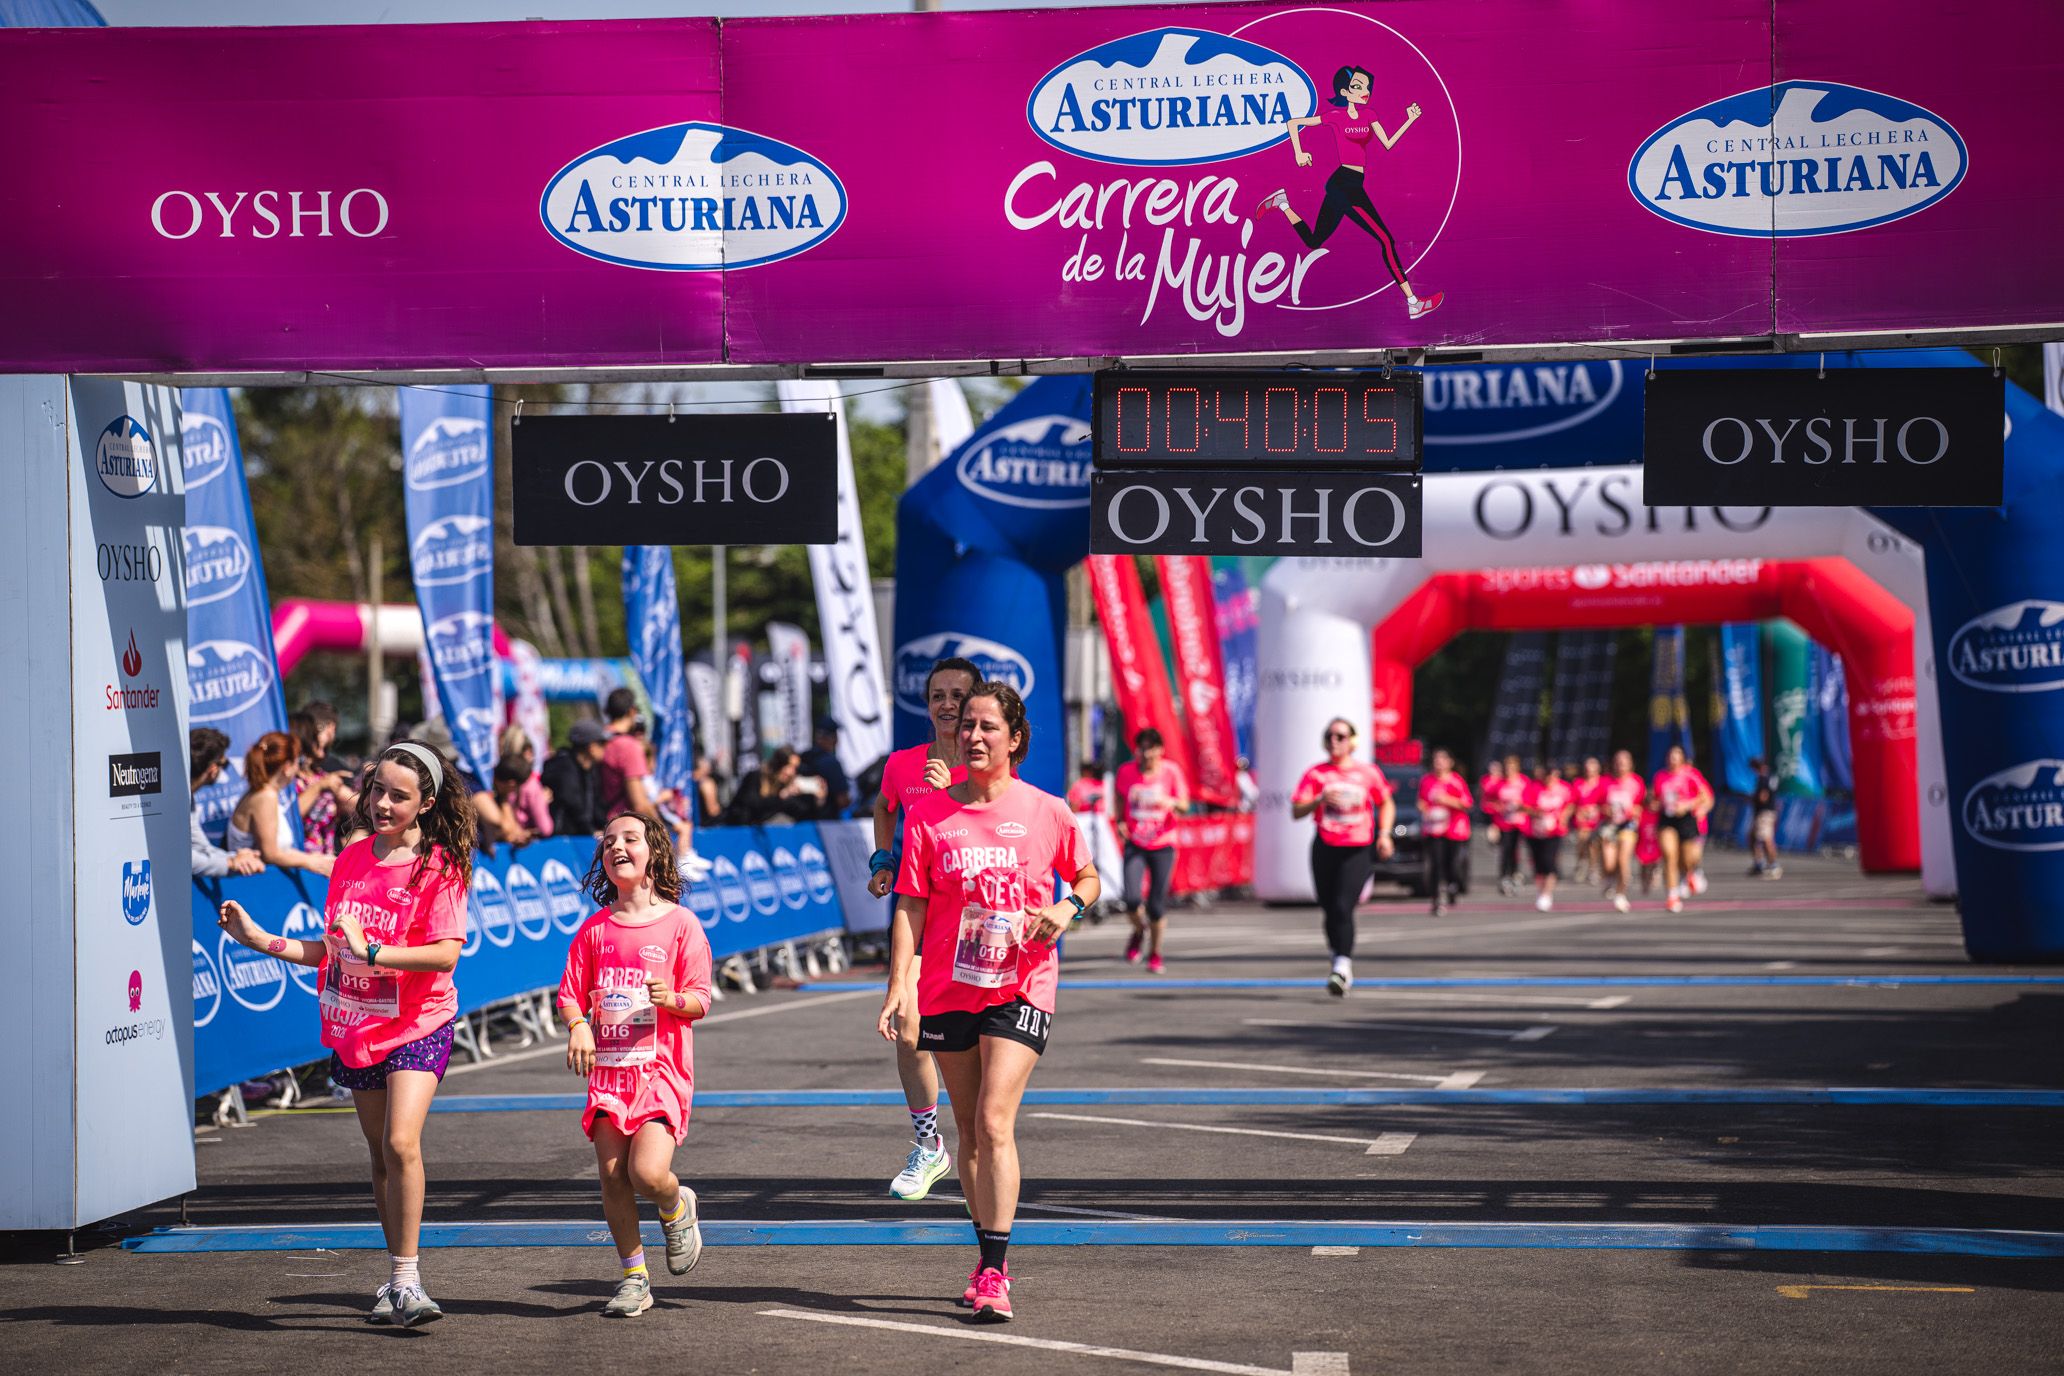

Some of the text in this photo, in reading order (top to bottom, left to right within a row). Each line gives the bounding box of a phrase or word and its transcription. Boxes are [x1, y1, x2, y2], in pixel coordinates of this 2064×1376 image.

[1093, 72, 1284, 91] CENTRAL LECHERA
[1049, 82, 1293, 133] ASTURIANA
[1345, 126, 1370, 134] OYSHO
[1706, 130, 1929, 153] CENTRAL LECHERA
[612, 172, 812, 189] CENTRAL LECHERA
[1654, 143, 1941, 201] ASTURIANA
[565, 179, 824, 233] ASTURIANA
[1003, 160, 1240, 230] Carrera
[151, 188, 389, 239] OYSHO
[1062, 217, 1330, 337] de la Mujer
[1117, 387, 1397, 452] 00:40:05
[1702, 416, 1950, 466] OYSHO
[100, 443, 154, 479] ASTURIANA
[564, 457, 789, 506] OYSHO
[1107, 484, 1406, 546] OYSHO
[97, 543, 162, 582] OYSHO
[1611, 557, 1763, 589] Santander
[106, 684, 160, 710] Santander
[112, 763, 158, 790] Neutrogena
[906, 786, 933, 794] OYSHO
[935, 828, 969, 842] OYSHO
[979, 945, 1007, 960] 016
[342, 974, 370, 990] 016
[601, 1024, 630, 1038] 016
[1016, 1005, 1041, 1036] 11
